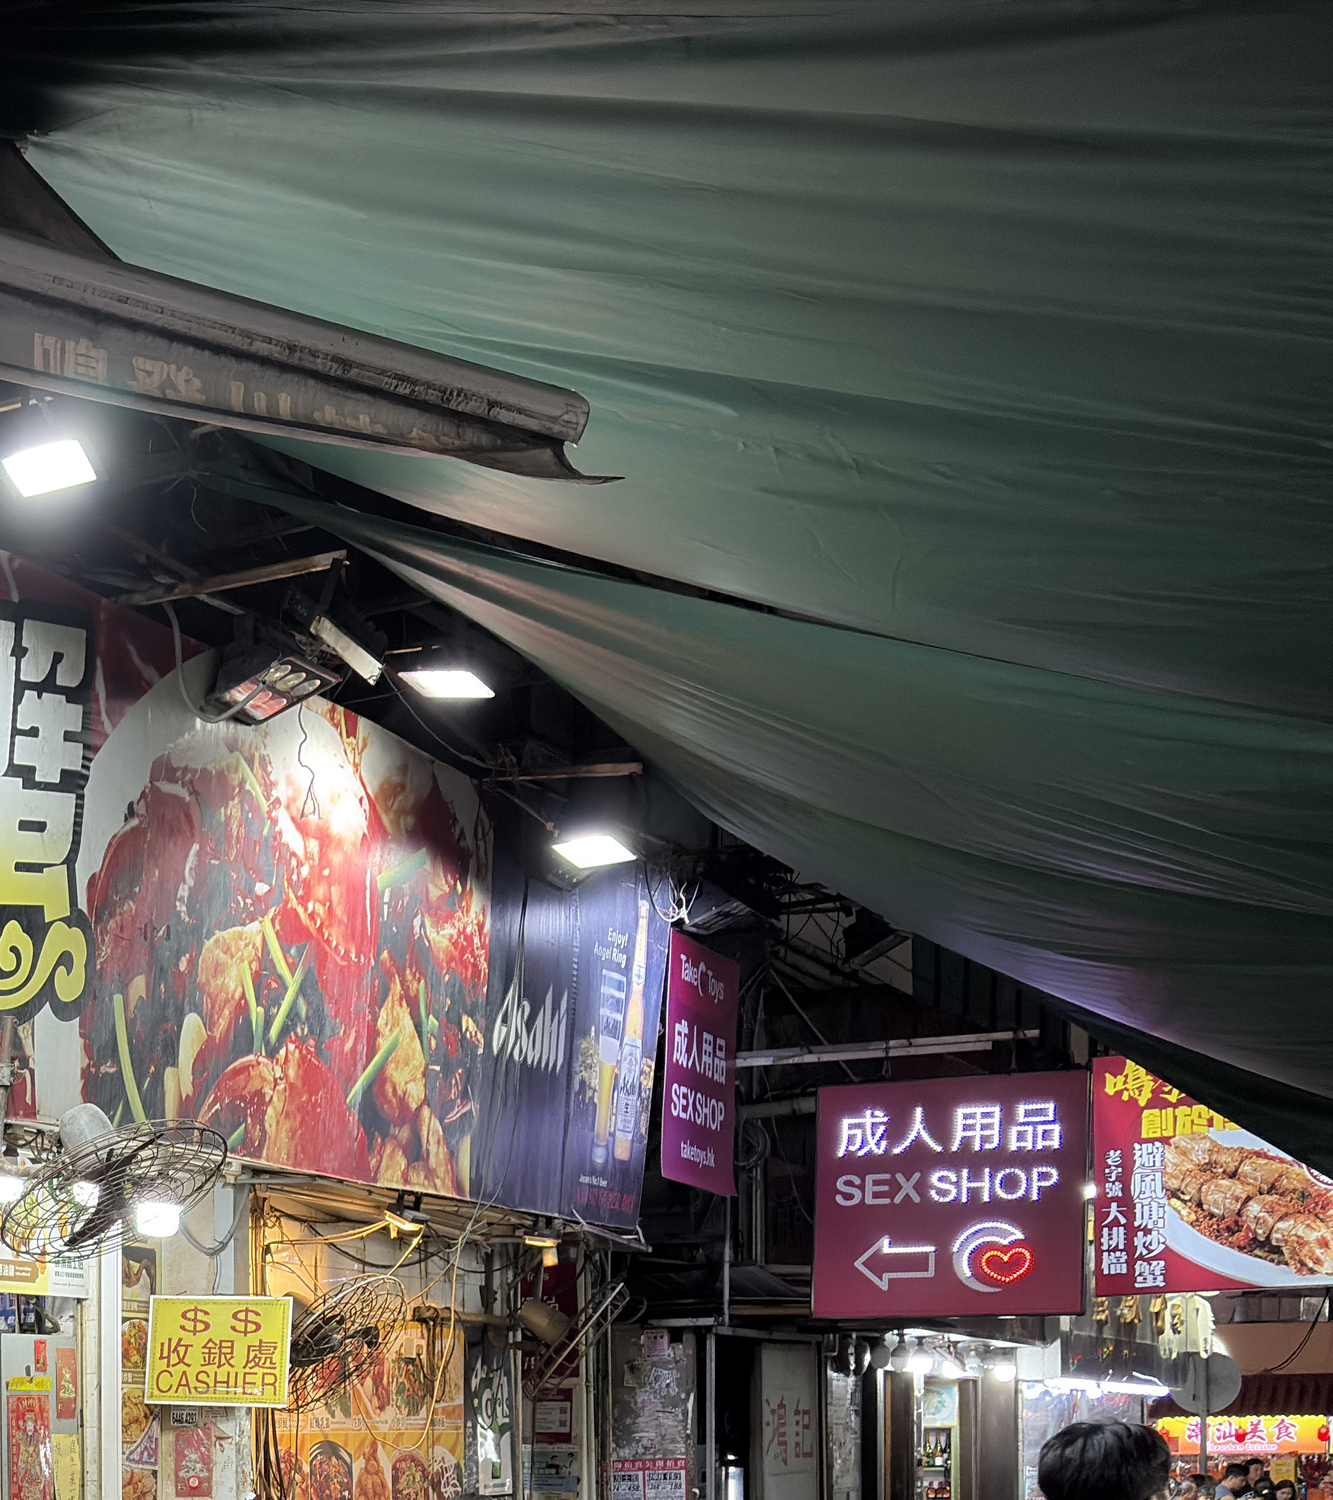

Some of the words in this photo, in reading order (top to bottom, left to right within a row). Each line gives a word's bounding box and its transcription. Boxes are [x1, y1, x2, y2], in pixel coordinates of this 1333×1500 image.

[593, 941, 612, 961] Angel
[612, 947, 627, 967] Ring
[608, 927, 629, 947] Enjoy!
[680, 954, 698, 986] Take
[707, 970, 725, 1001] Toys
[491, 985, 569, 1076] Asahi
[672, 1022, 727, 1086] 成人用品
[671, 1085, 694, 1122] SEX
[694, 1094, 726, 1132] SHOP
[836, 1100, 1063, 1158] 成人用品
[680, 1140, 716, 1169] taketoys.hk
[835, 1171, 922, 1206] SEX
[929, 1166, 1060, 1205] SHOP
[1101, 1149, 1128, 1276] 老字號大排檔
[1132, 1141, 1166, 1288] 避風塘炒蟹
[179, 1306, 211, 1336] $
[230, 1307, 262, 1337] $
[158, 1337, 278, 1370] 收銀處
[156, 1369, 278, 1396] CASHIER
